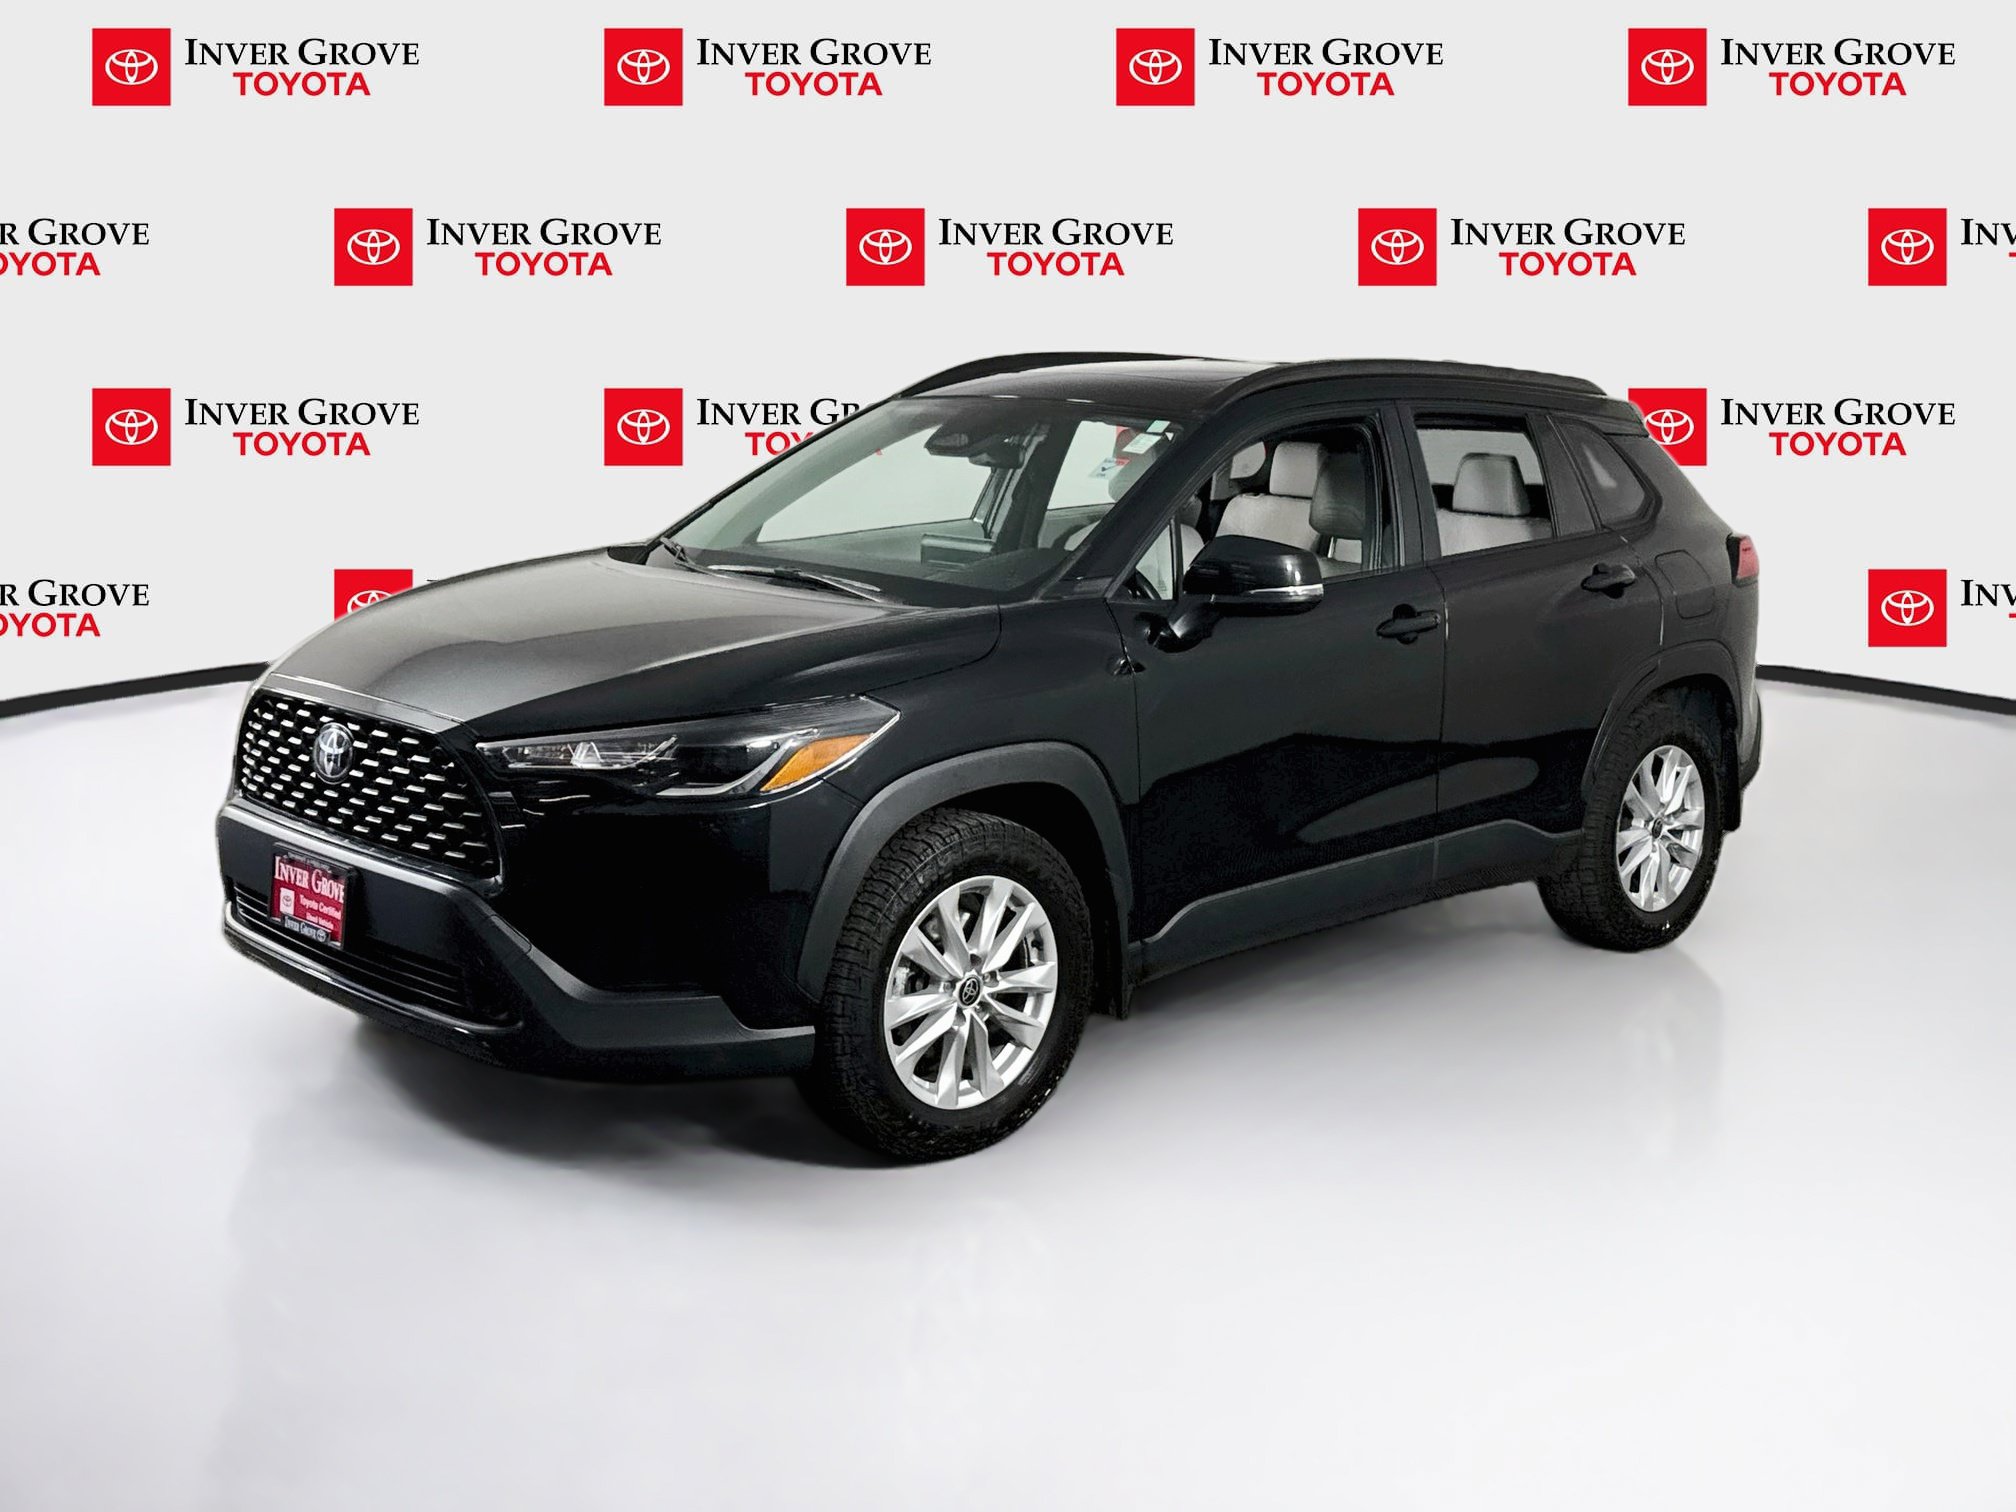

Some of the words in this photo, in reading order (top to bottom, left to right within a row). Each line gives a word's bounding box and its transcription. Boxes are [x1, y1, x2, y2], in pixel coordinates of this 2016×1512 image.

[184, 38, 289, 65] INVER
[297, 38, 419, 65] GROVE
[696, 38, 801, 65] INVER
[809, 38, 931, 65] GROVE
[1208, 38, 1313, 65] INVER
[1321, 38, 1443, 65] GROVE
[1720, 38, 1825, 65] INVER
[1833, 38, 1955, 65] GROVE
[232, 72, 371, 97] TOYOTA
[744, 72, 883, 97] TOYOTA
[1256, 72, 1395, 97] TOYOTA
[1768, 72, 1907, 97] TOYOTA
[27, 218, 150, 245] GROVE
[426, 218, 532, 245] INVER
[539, 218, 662, 245] GROVE
[938, 218, 1044, 245] INVER
[1051, 218, 1174, 245] GROVE
[1450, 218, 1556, 245] INVER
[1563, 218, 1686, 245] GROVE
[474, 252, 613, 276] TOYOTA
[986, 252, 1125, 276] TOYOTA
[1498, 252, 1637, 276] TOYOTA
[184, 398, 290, 425] INVER
[298, 398, 420, 425] GROVE
[696, 398, 802, 425] INVER
[1720, 398, 1826, 425] INVER
[1834, 398, 1956, 425] GROVE
[232, 432, 371, 456] TOYOTA
[1768, 432, 1907, 456] TOYOTA
[27, 579, 150, 606] GROVE
[274, 856, 309, 889] INVER
[312, 869, 345, 903] GROVE
